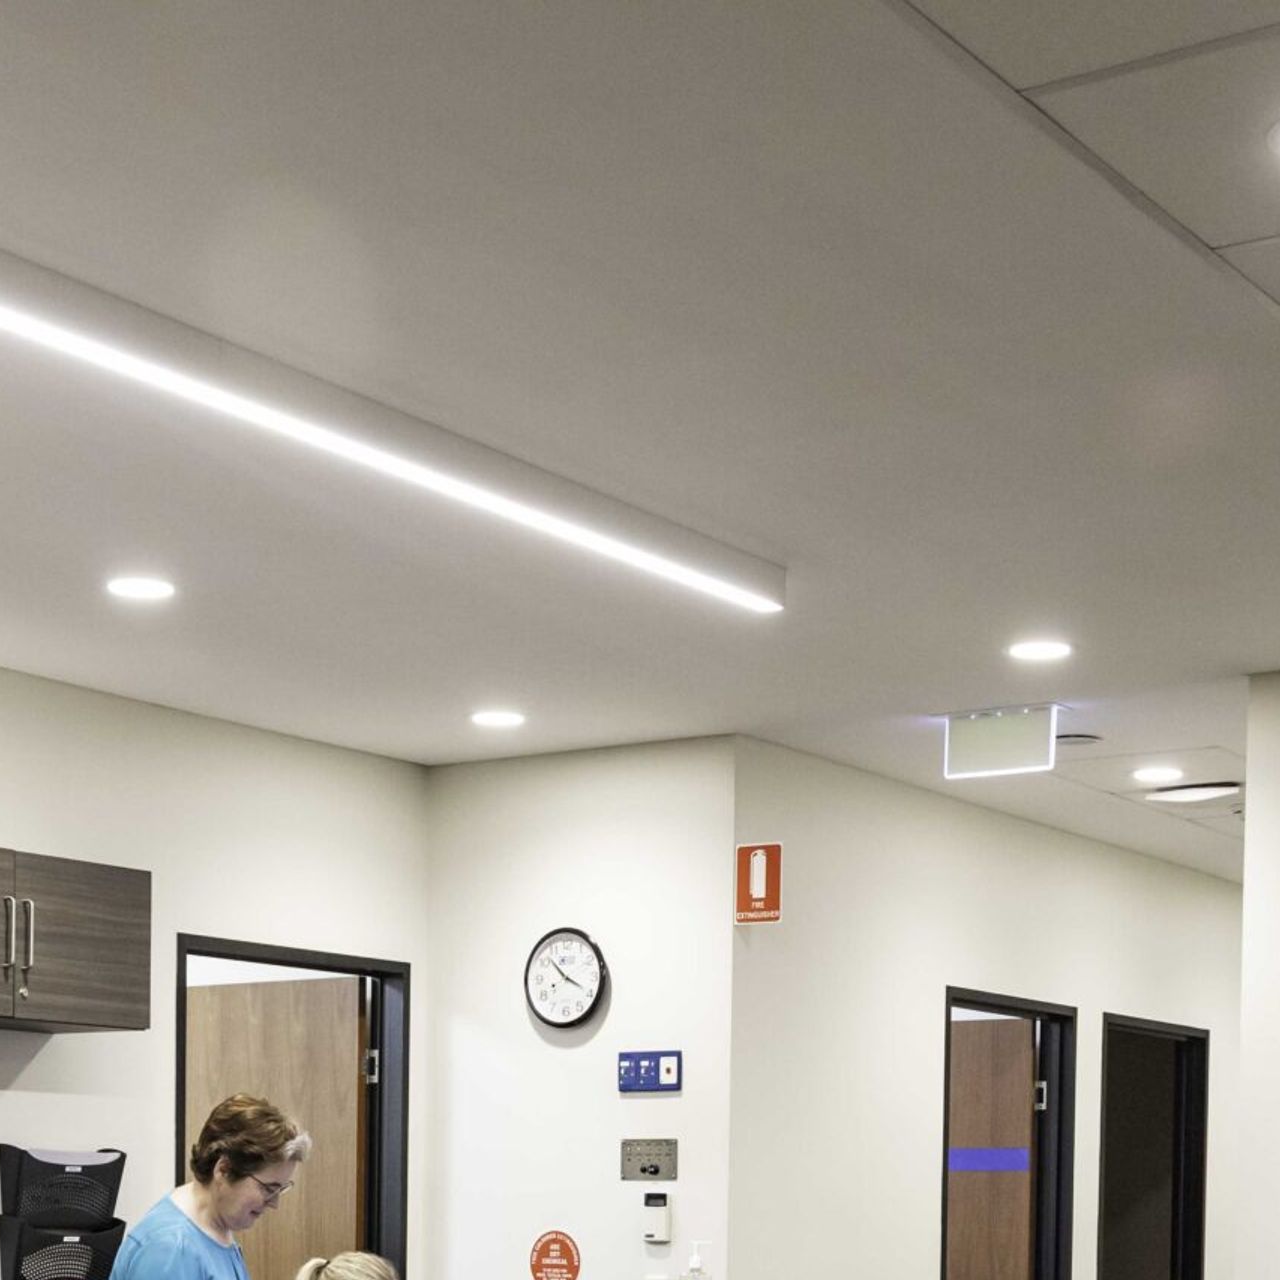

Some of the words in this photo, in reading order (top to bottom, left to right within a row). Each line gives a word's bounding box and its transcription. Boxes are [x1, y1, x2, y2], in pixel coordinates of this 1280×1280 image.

[751, 900, 765, 909] FIRE
[737, 910, 780, 919] EXTINGUISHER
[586, 988, 594, 998] 4
[562, 1005, 571, 1017] 6
[575, 1000, 585, 1012] 5
